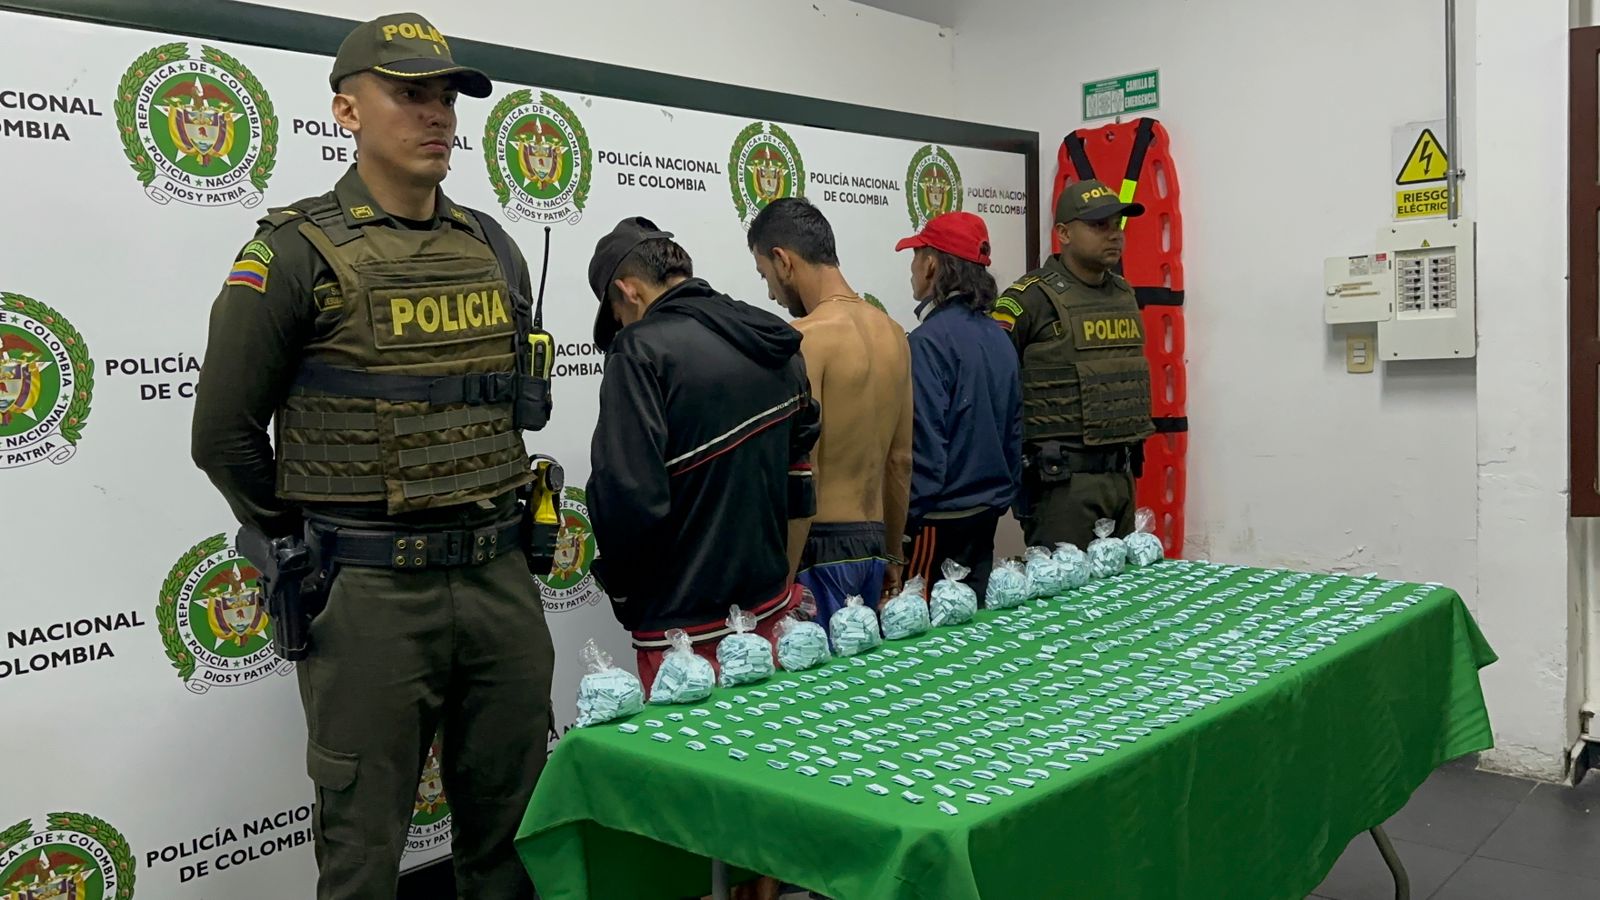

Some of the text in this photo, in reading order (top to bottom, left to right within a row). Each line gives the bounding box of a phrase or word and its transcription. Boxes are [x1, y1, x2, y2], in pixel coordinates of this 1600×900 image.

[0, 91, 102, 116] CIONAL
[138, 62, 260, 139] REPÚBLICA DE COLOMBIA
[0, 119, 71, 141] MBIA
[293, 118, 353, 139] POLIC
[532, 105, 544, 114] DE
[552, 113, 580, 168] COLOMBIA
[322, 146, 348, 163] DE
[598, 150, 722, 175] POLICÍA NACIONAL
[763, 134, 772, 143] DE
[777, 141, 797, 187] COLOMBIA
[206, 152, 257, 187] NACIONAL
[810, 172, 901, 191] POLICÍA NACIONAL
[543, 180, 578, 208] NACIONAL
[617, 172, 707, 192] DE COLOMBIA
[206, 186, 247, 203] PATRIA
[824, 190, 889, 206] DE COLOMBIA
[999, 190, 1027, 201] NACION
[544, 207, 571, 221] PATRIA
[977, 202, 988, 213] DE
[1397, 202, 1448, 214] ELÉCTRIC
[390, 289, 508, 336] POLICIA
[1083, 318, 1141, 341] POLICIA
[23, 319, 72, 388] COLOMBIA
[105, 352, 201, 376] POLICÍA
[551, 362, 604, 377] OMBIA
[140, 383, 171, 400] DE
[6, 402, 68, 448] NACIONAL
[7, 441, 56, 464] PATRIA
[179, 549, 238, 627] REPÚBLICA D
[566, 590, 593, 608] PATRIA
[7, 610, 145, 649] NACIONAL
[0, 641, 115, 678] OLOMBIA
[244, 656, 282, 681] PATRIA
[146, 803, 316, 868] POLICÍA NACIO
[434, 831, 450, 844] PAT
[33, 833, 115, 889] DE COLOMBIA
[179, 828, 315, 883] DE COLOMBI
